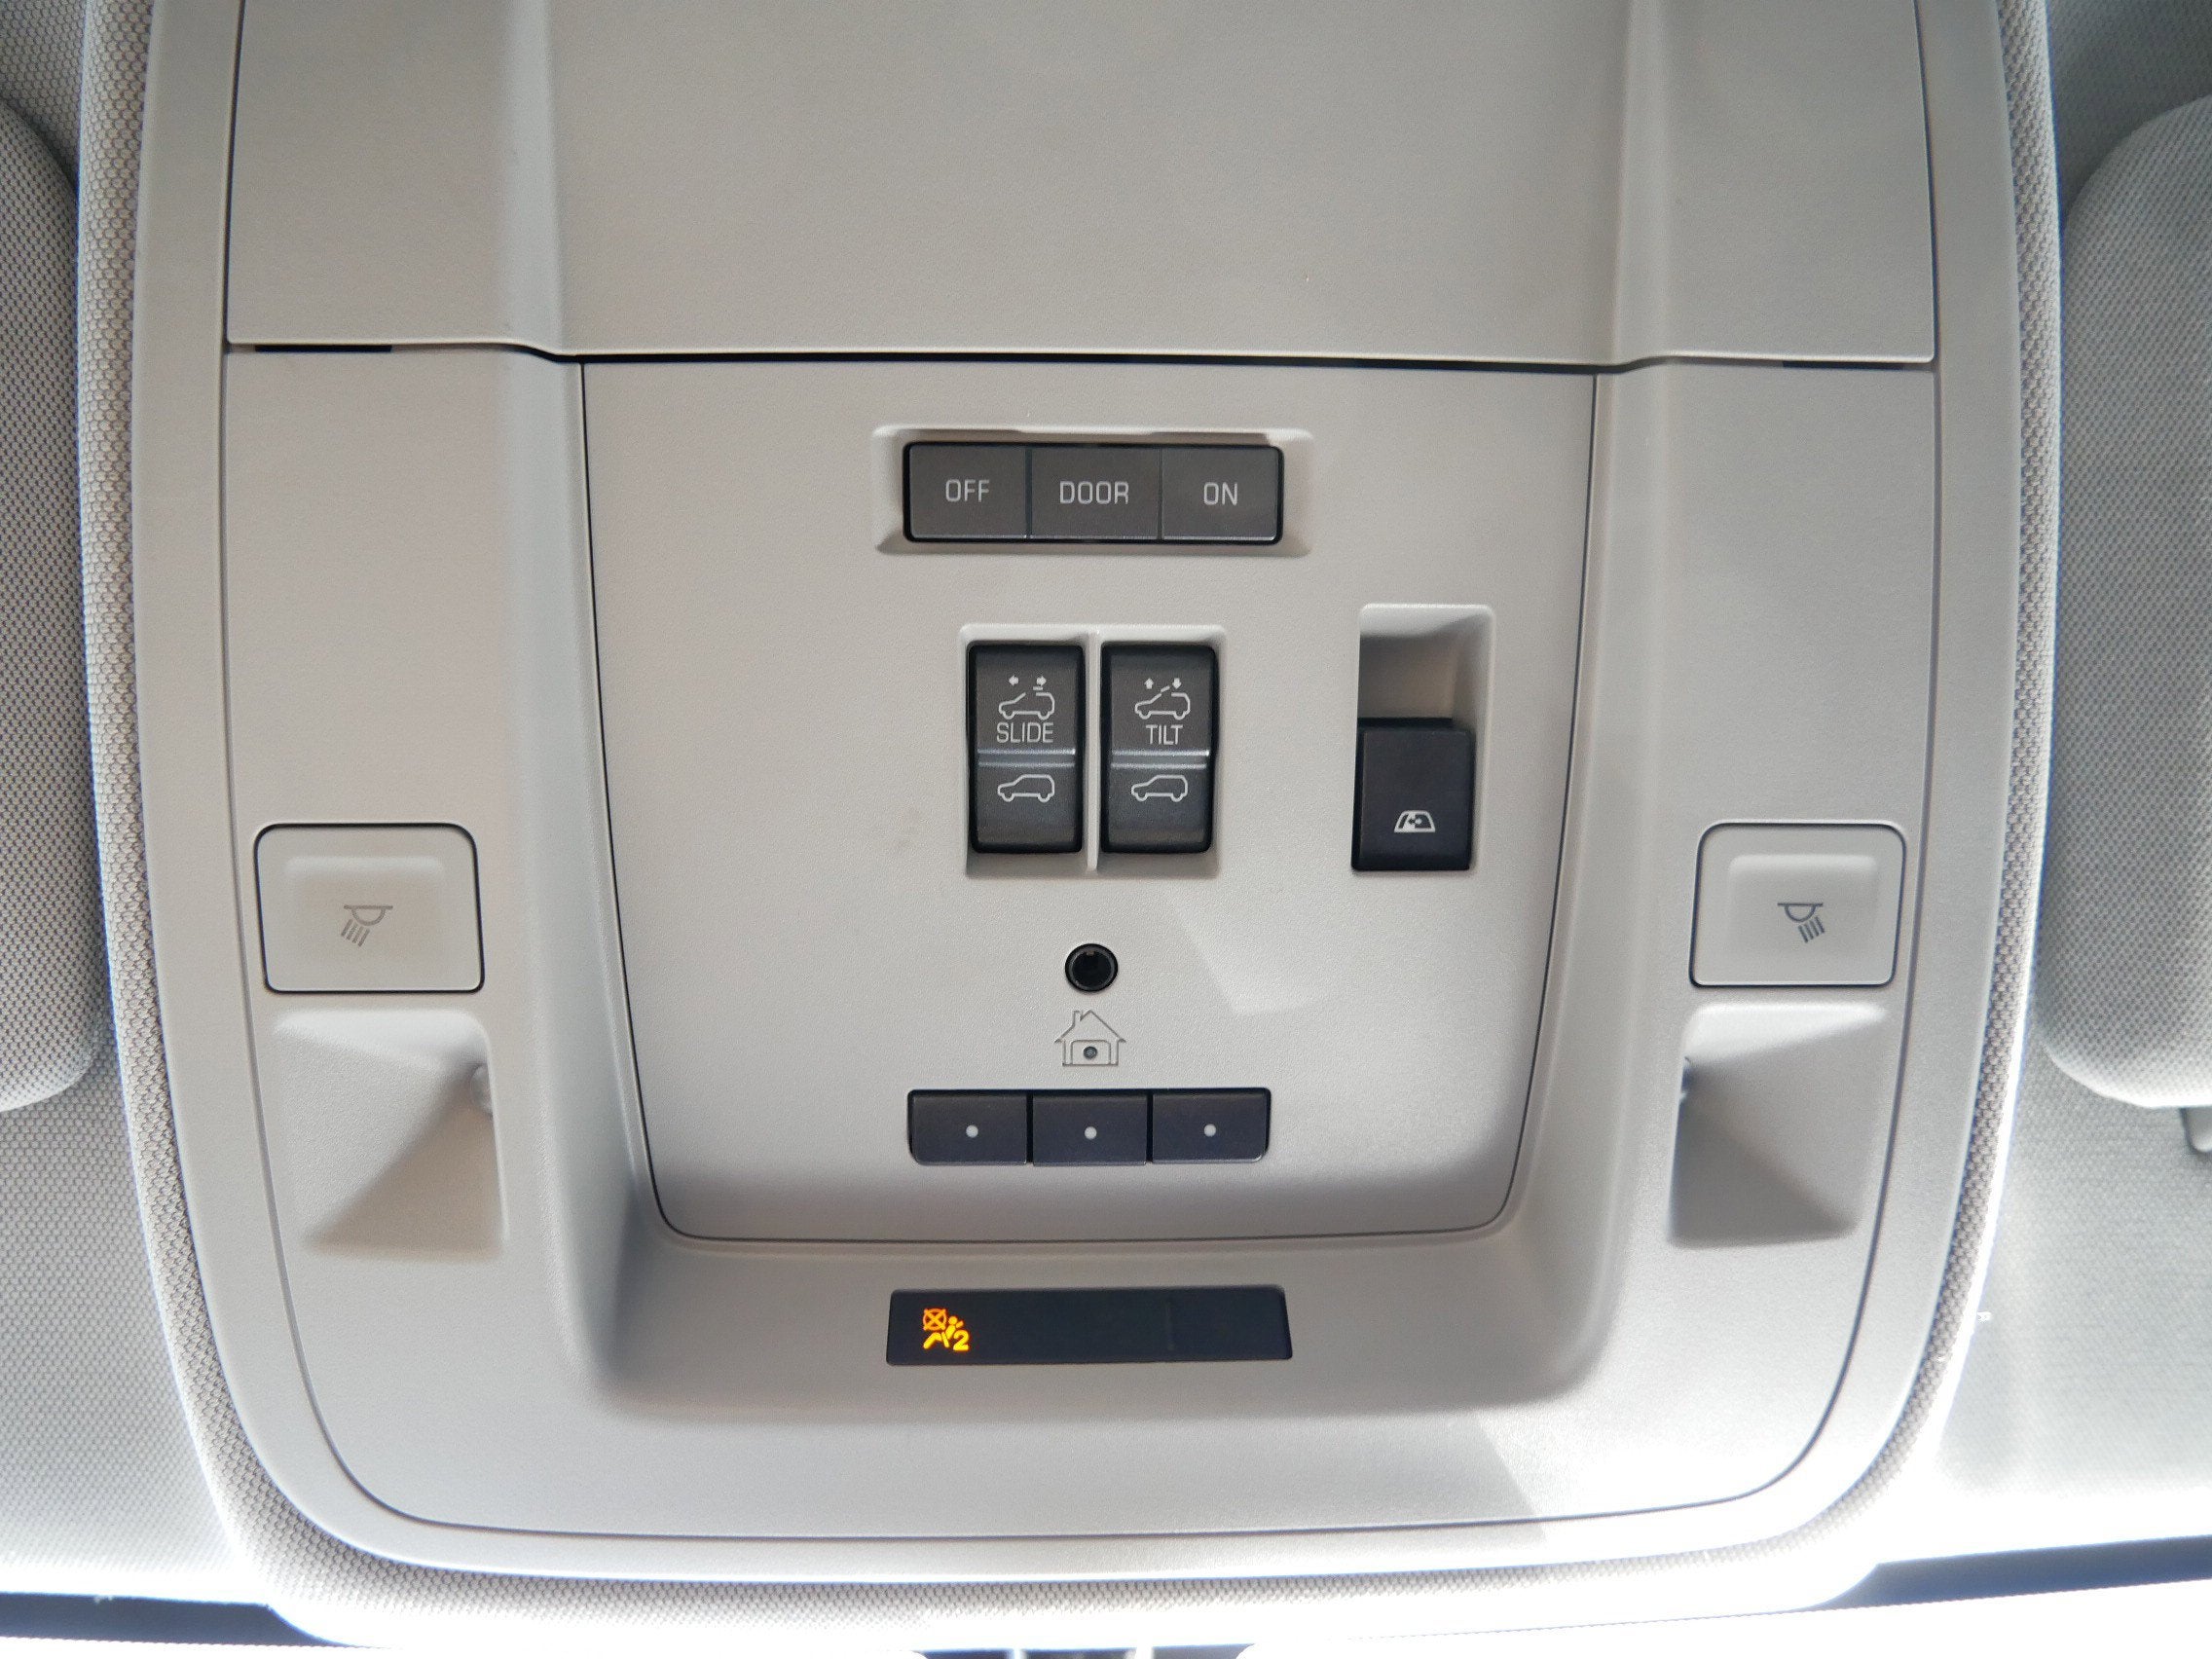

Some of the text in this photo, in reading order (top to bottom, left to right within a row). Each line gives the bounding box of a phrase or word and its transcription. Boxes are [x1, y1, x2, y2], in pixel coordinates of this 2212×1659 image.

[945, 479, 990, 502] OFF
[1059, 481, 1129, 504] DOOR
[1203, 482, 1238, 505] ON
[996, 721, 1053, 743] SLIDE
[1145, 724, 1184, 745] TILT
[952, 1330, 970, 1351] 2
